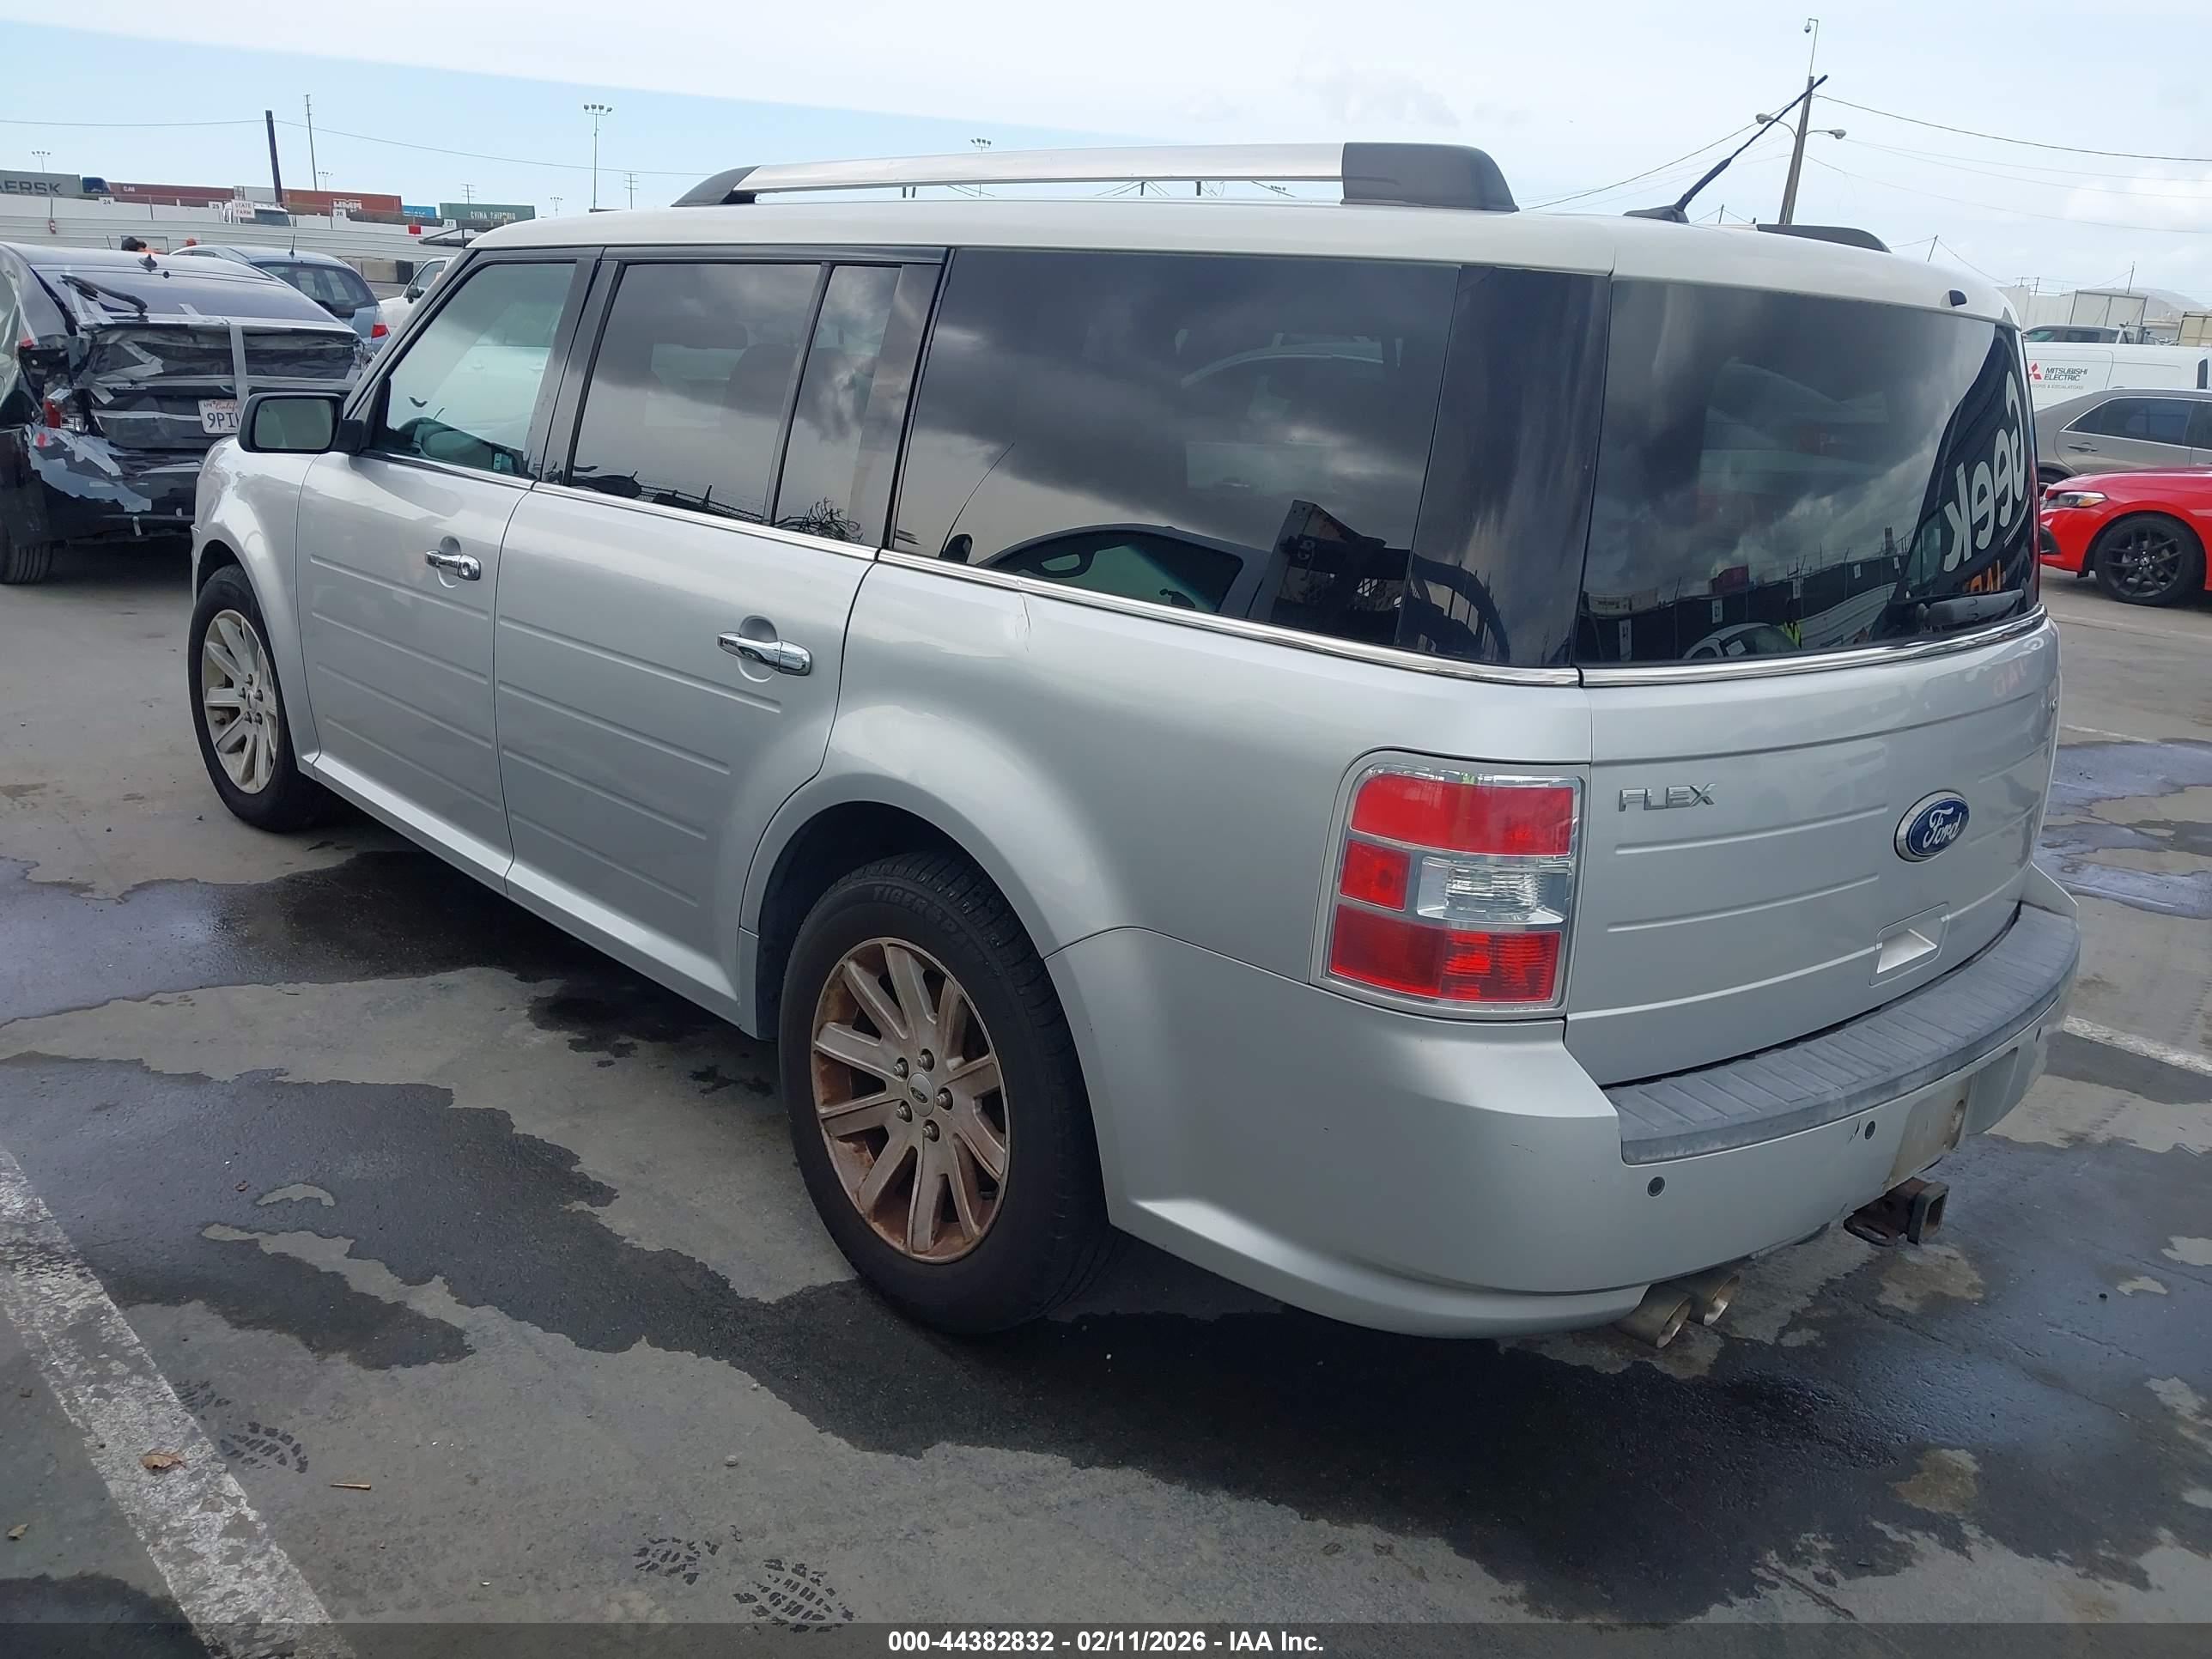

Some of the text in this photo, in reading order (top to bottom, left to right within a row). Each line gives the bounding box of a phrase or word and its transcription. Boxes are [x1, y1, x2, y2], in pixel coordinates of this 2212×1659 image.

[470, 211, 488, 220] CHINA
[2045, 367, 2088, 375] MITSUBISHI
[1618, 782, 1717, 812] FLEX
[1923, 806, 1962, 848] Ford
